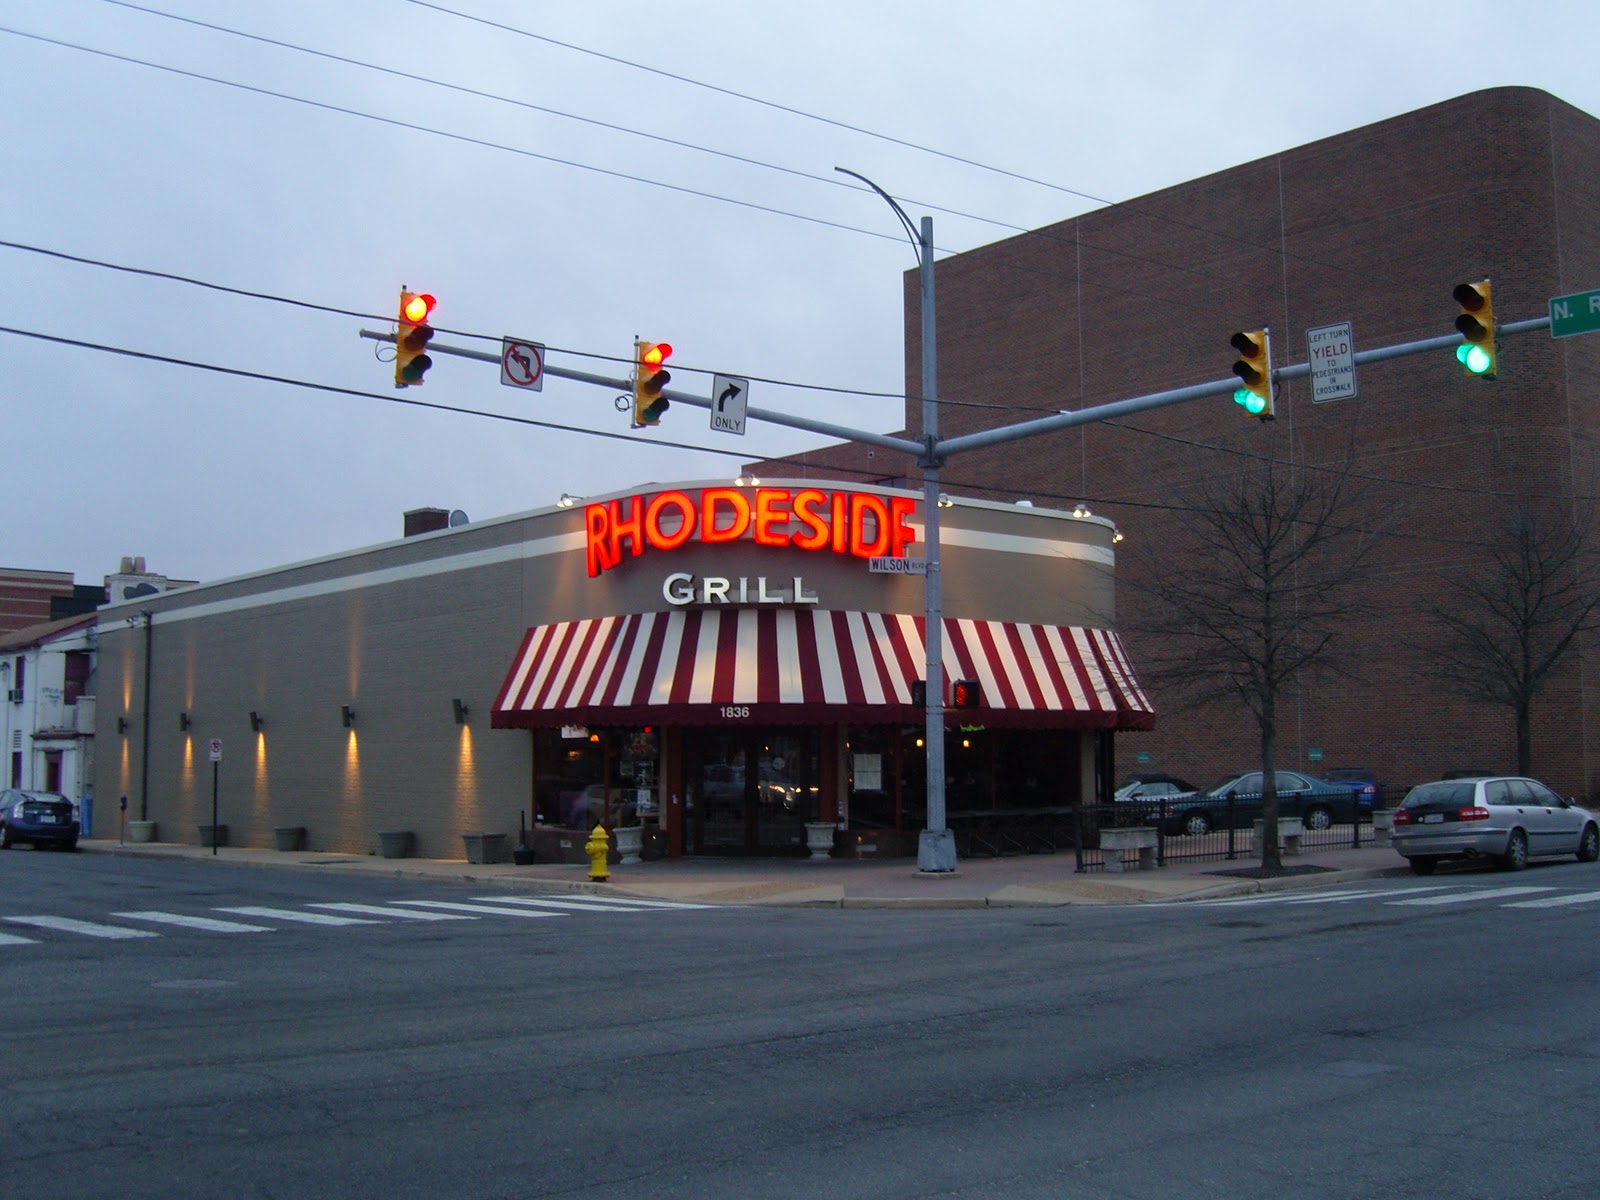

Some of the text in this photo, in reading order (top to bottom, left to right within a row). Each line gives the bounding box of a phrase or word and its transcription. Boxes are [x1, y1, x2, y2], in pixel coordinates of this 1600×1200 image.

[1554, 301, 1574, 320] N.
[1310, 329, 1349, 343] LEFT TURN
[1312, 343, 1348, 359] YIELD
[1312, 365, 1352, 379] PEDESTRIANS
[1316, 383, 1352, 396] CROSSWALK
[715, 416, 741, 431] ONLY
[585, 488, 916, 577] RHODESIDE
[871, 558, 910, 571] WILSON
[662, 573, 819, 605] GRILL
[720, 706, 750, 718] 1836
